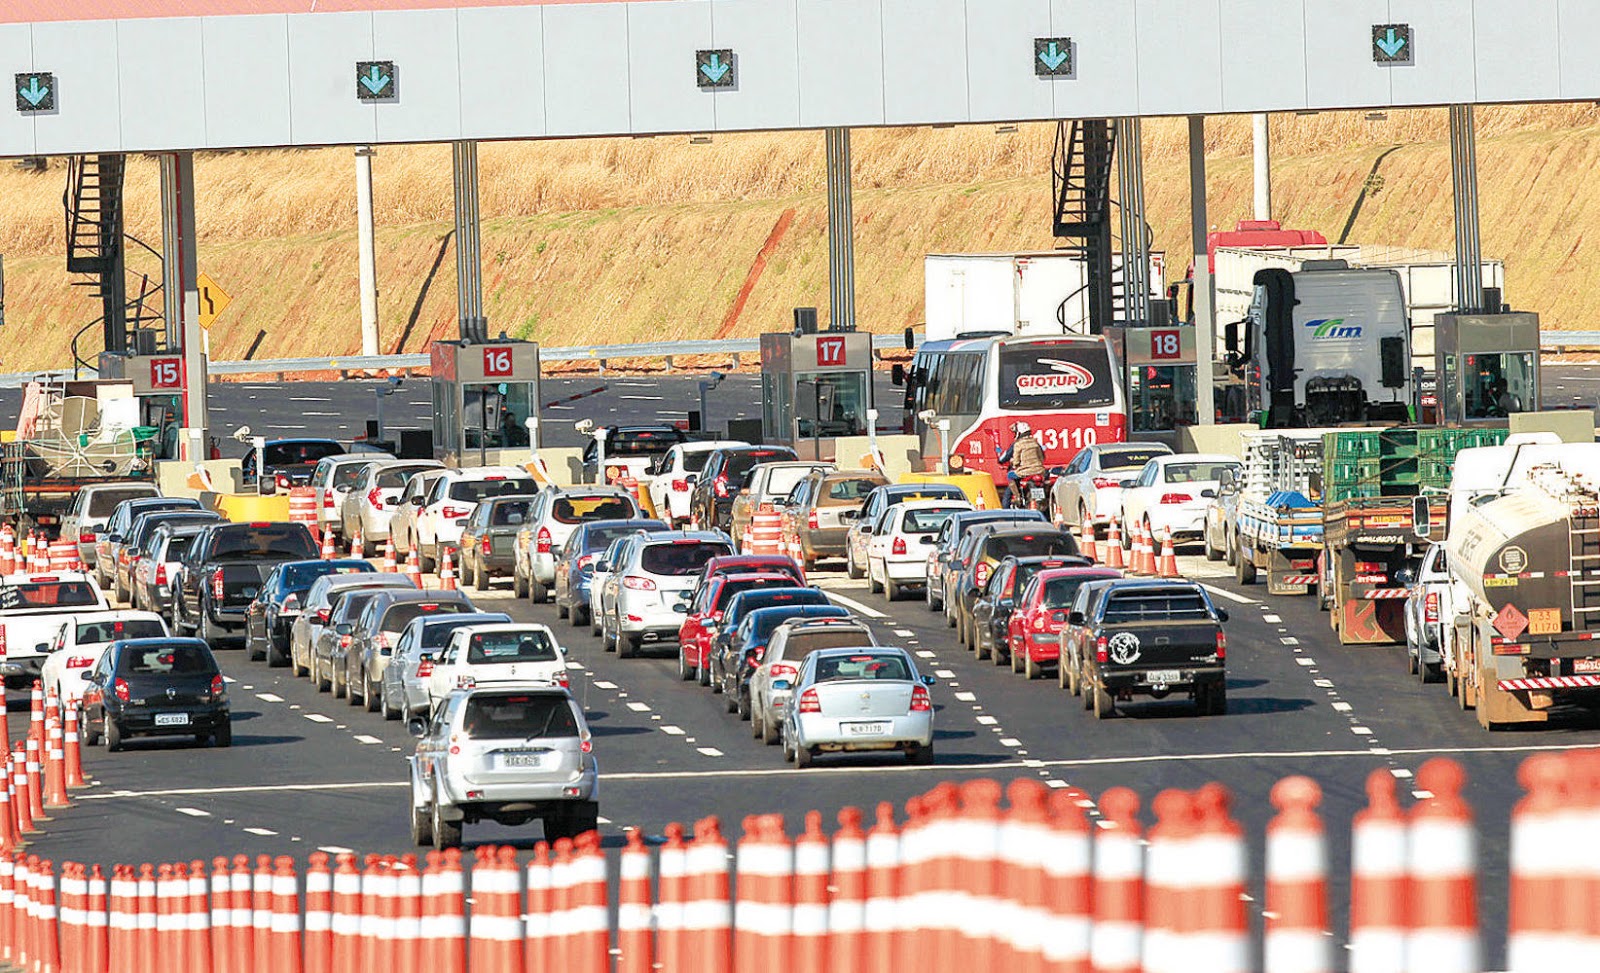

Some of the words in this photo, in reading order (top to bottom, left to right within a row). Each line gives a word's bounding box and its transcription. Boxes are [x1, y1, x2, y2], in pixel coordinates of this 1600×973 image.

[820, 341, 842, 361] 17
[1154, 334, 1178, 354] 18
[486, 351, 510, 372] 16
[154, 363, 177, 384] 15
[1018, 374, 1079, 388] GIOTUR
[1033, 427, 1097, 450] 13110
[1539, 612, 1551, 621] 33
[1535, 622, 1559, 632] 1170
